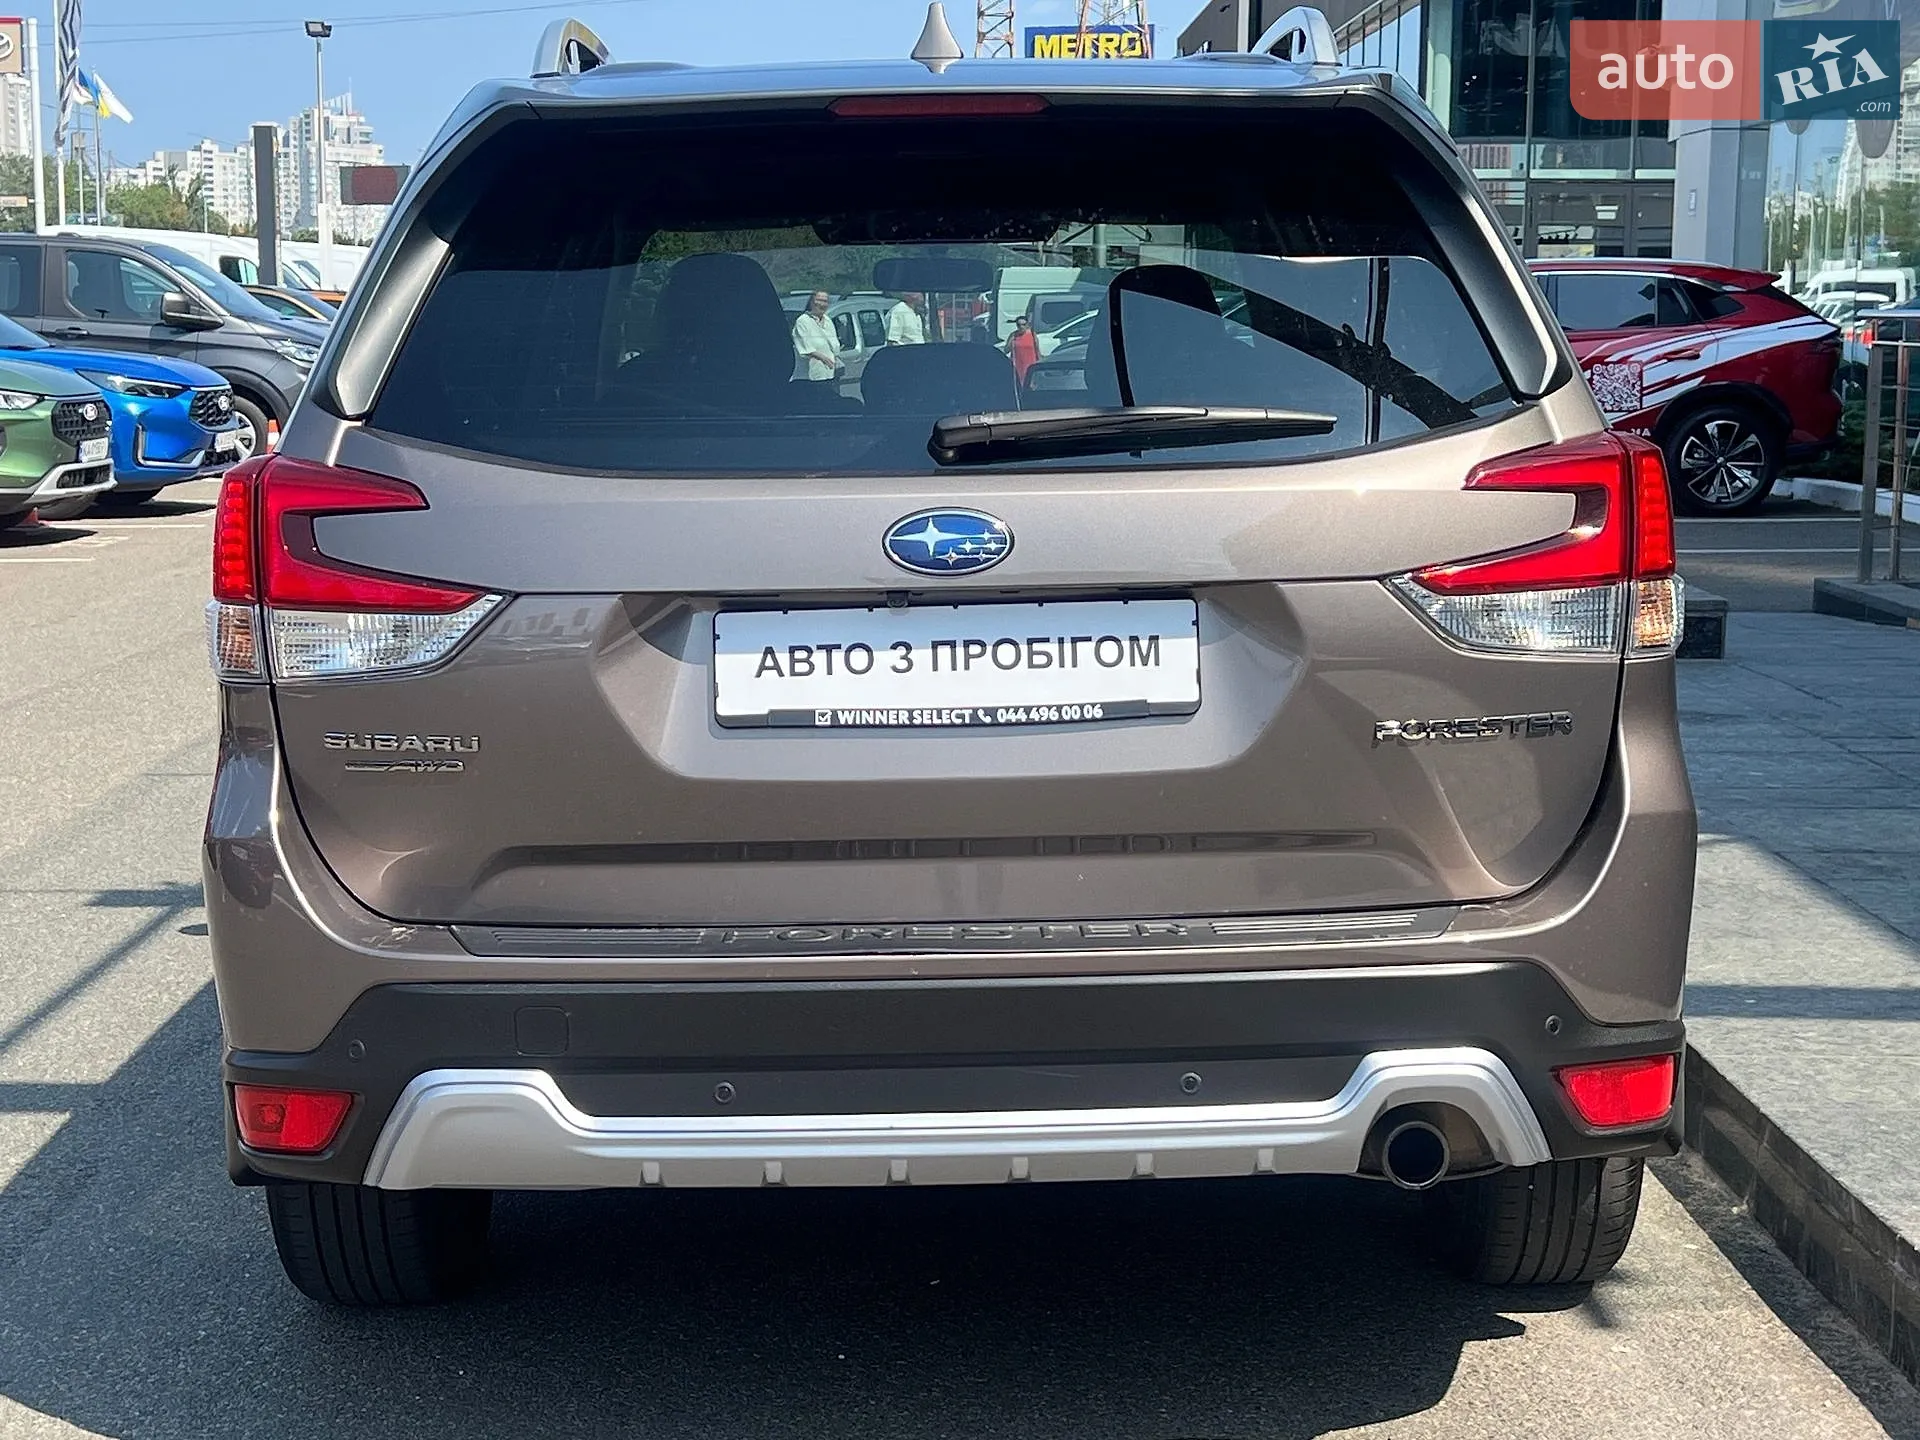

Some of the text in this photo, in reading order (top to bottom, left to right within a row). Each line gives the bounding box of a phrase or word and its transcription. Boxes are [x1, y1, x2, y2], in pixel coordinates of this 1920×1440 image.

[1034, 32, 1142, 58] METRO
[754, 635, 1160, 678] АВТО З ПРОБІГОМ
[836, 704, 1104, 725] WINNER SELECT 044 496 00 06
[1374, 709, 1575, 742] FORESTER
[323, 731, 480, 752] SUBARU
[387, 760, 465, 772] AWD
[722, 922, 1189, 945] FORESTER
